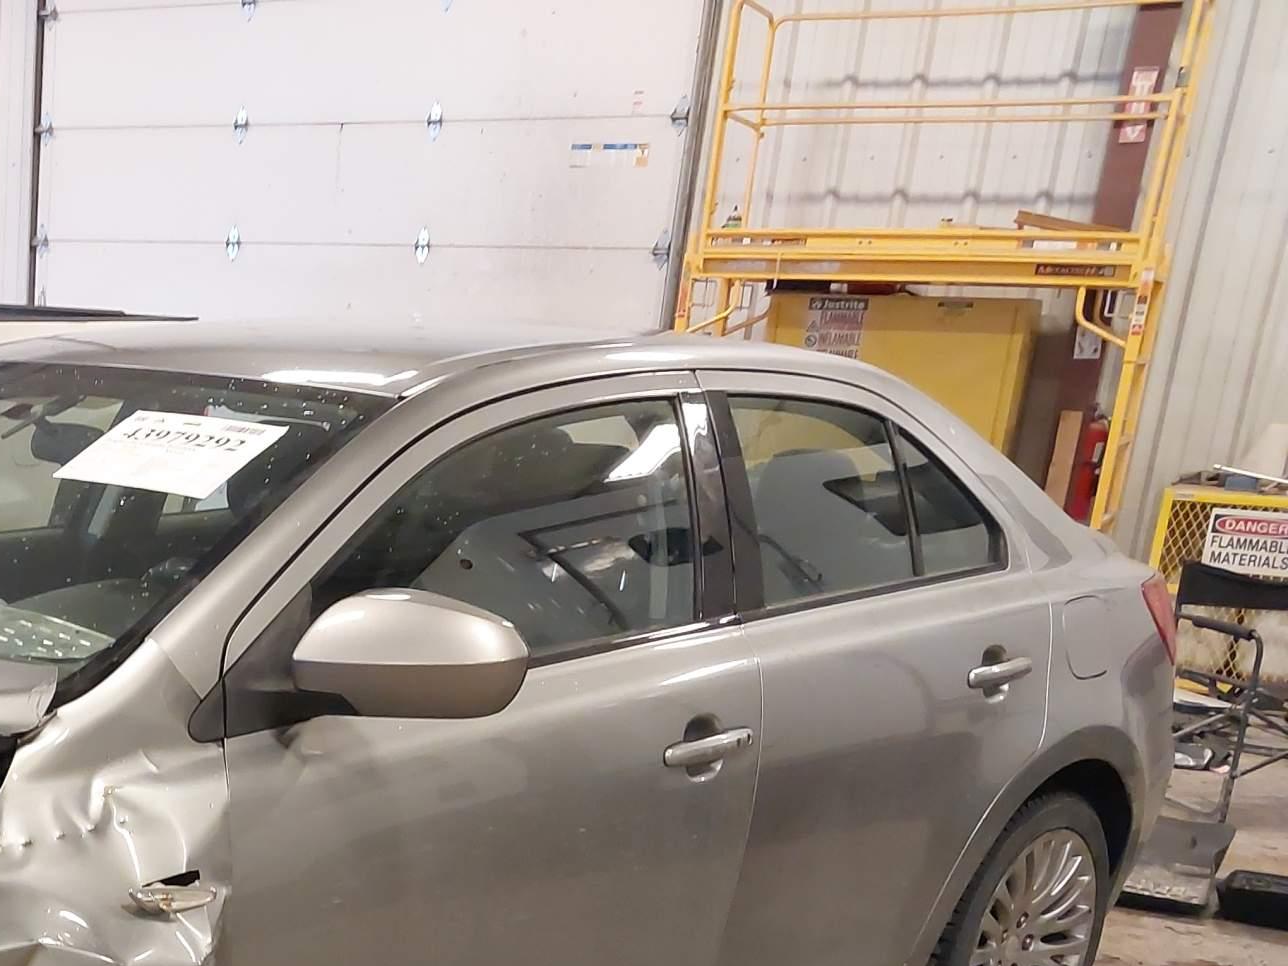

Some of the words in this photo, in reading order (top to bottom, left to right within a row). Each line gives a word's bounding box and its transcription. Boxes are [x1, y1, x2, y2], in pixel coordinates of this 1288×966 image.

[823, 299, 866, 310] Justrite
[123, 427, 246, 451] 43979292
[1224, 519, 1288, 535] DANGER
[1210, 535, 1288, 554] FLAMMABL
[1209, 551, 1288, 570] MATERIALS
